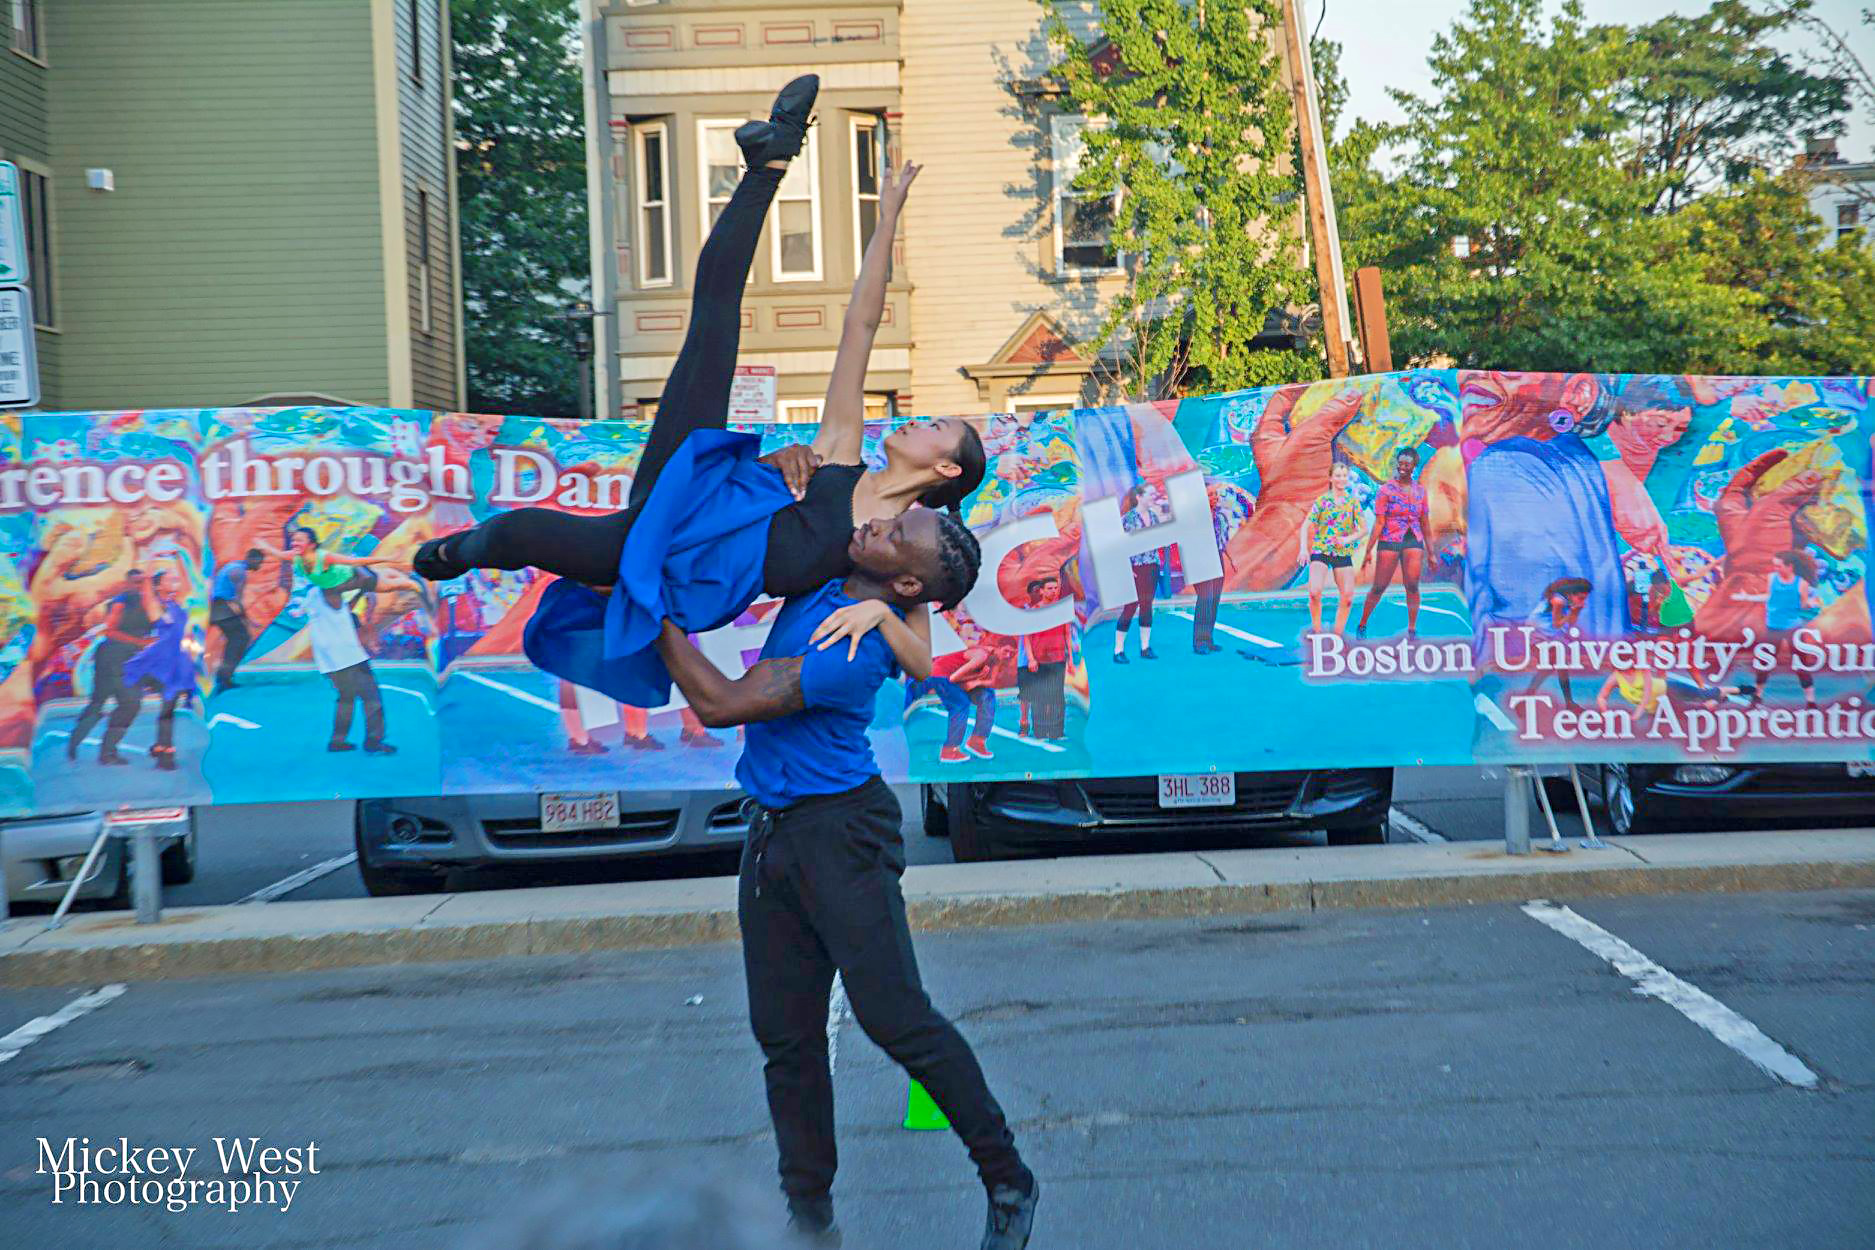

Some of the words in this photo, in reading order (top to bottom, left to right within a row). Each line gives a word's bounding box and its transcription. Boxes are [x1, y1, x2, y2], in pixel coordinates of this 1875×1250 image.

[0, 463, 184, 508] rence
[203, 441, 473, 511] through
[493, 448, 633, 510] Dan
[1307, 632, 1475, 678] Boston
[1488, 625, 1777, 682] University's
[1509, 694, 1633, 740] Teen
[1163, 777, 1194, 797] 3HL
[1199, 776, 1231, 796] 388
[546, 803, 577, 824] 984
